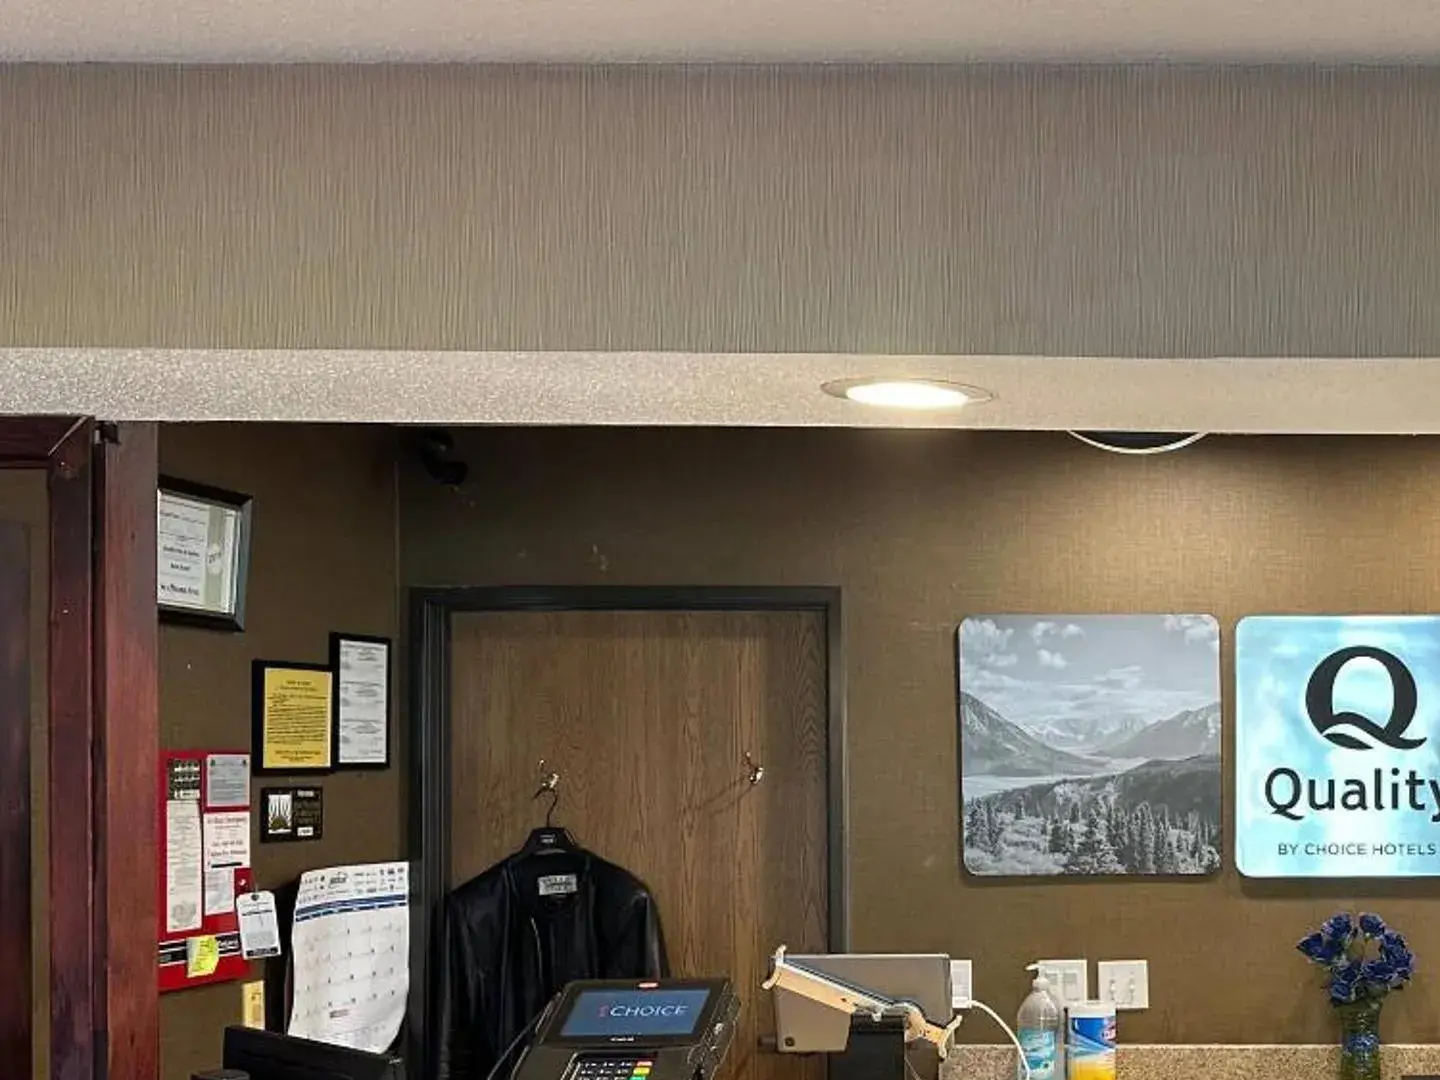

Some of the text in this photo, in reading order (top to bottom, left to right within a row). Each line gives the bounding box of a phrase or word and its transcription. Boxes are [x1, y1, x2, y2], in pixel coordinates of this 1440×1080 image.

[1306, 645, 1428, 750] Q
[1278, 843, 1438, 856] BY CHOICE HOTELS
[609, 1004, 689, 1017] CHOICE
